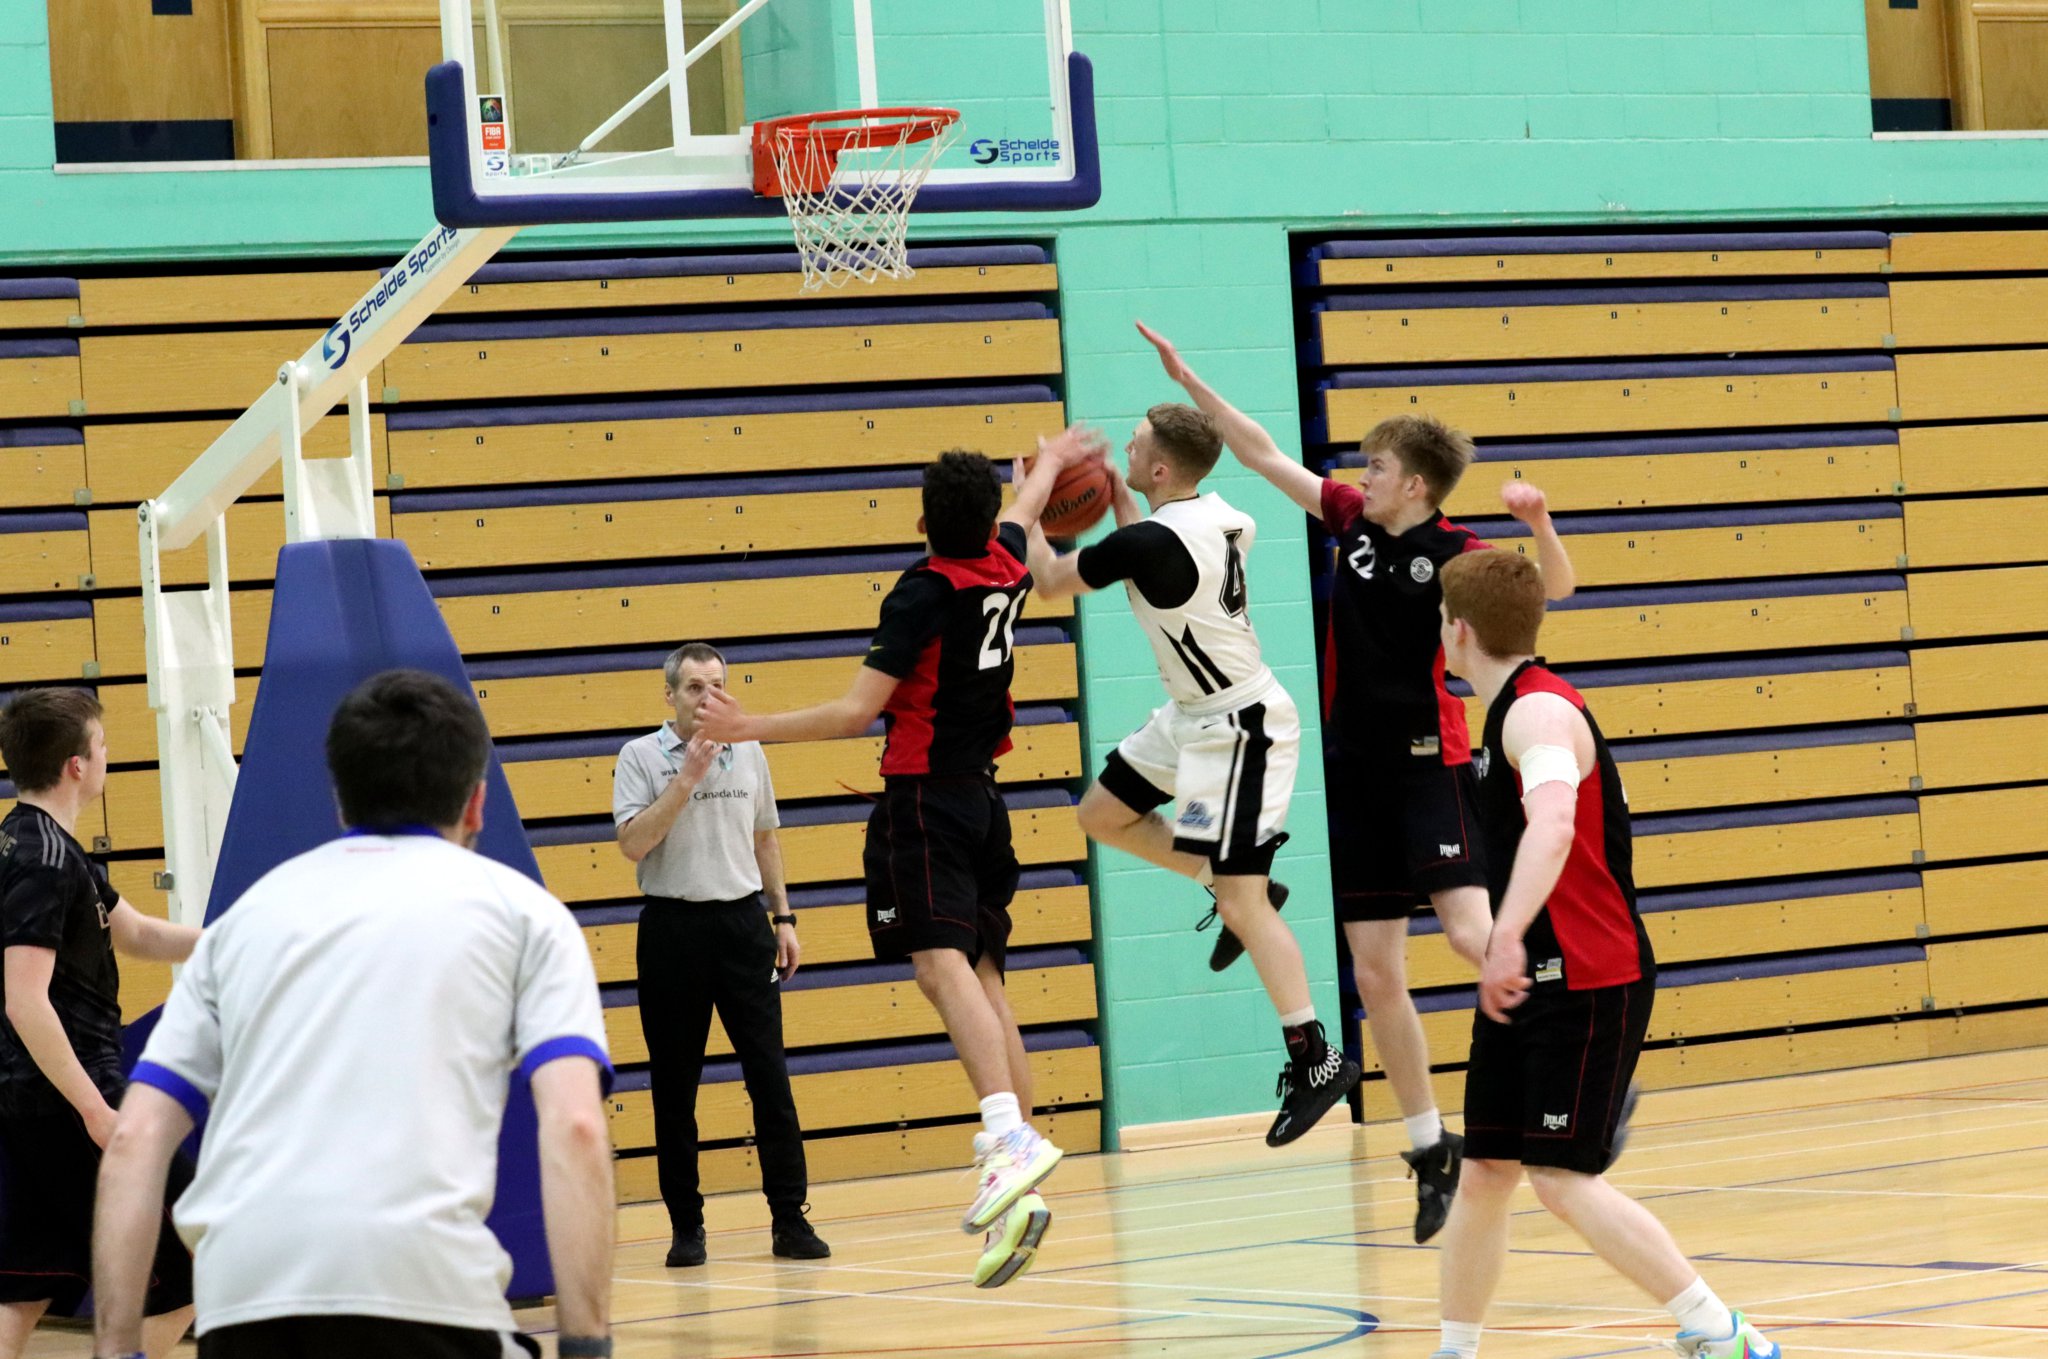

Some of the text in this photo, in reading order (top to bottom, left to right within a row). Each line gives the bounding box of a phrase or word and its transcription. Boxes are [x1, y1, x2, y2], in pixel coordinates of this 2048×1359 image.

[485, 127, 501, 136] FIBA
[999, 138, 1059, 150] Schelde
[1000, 151, 1060, 165] Sports
[349, 226, 457, 334] Schelde Sports
[1219, 528, 1247, 619] 4
[693, 789, 749, 801] Canada Life
